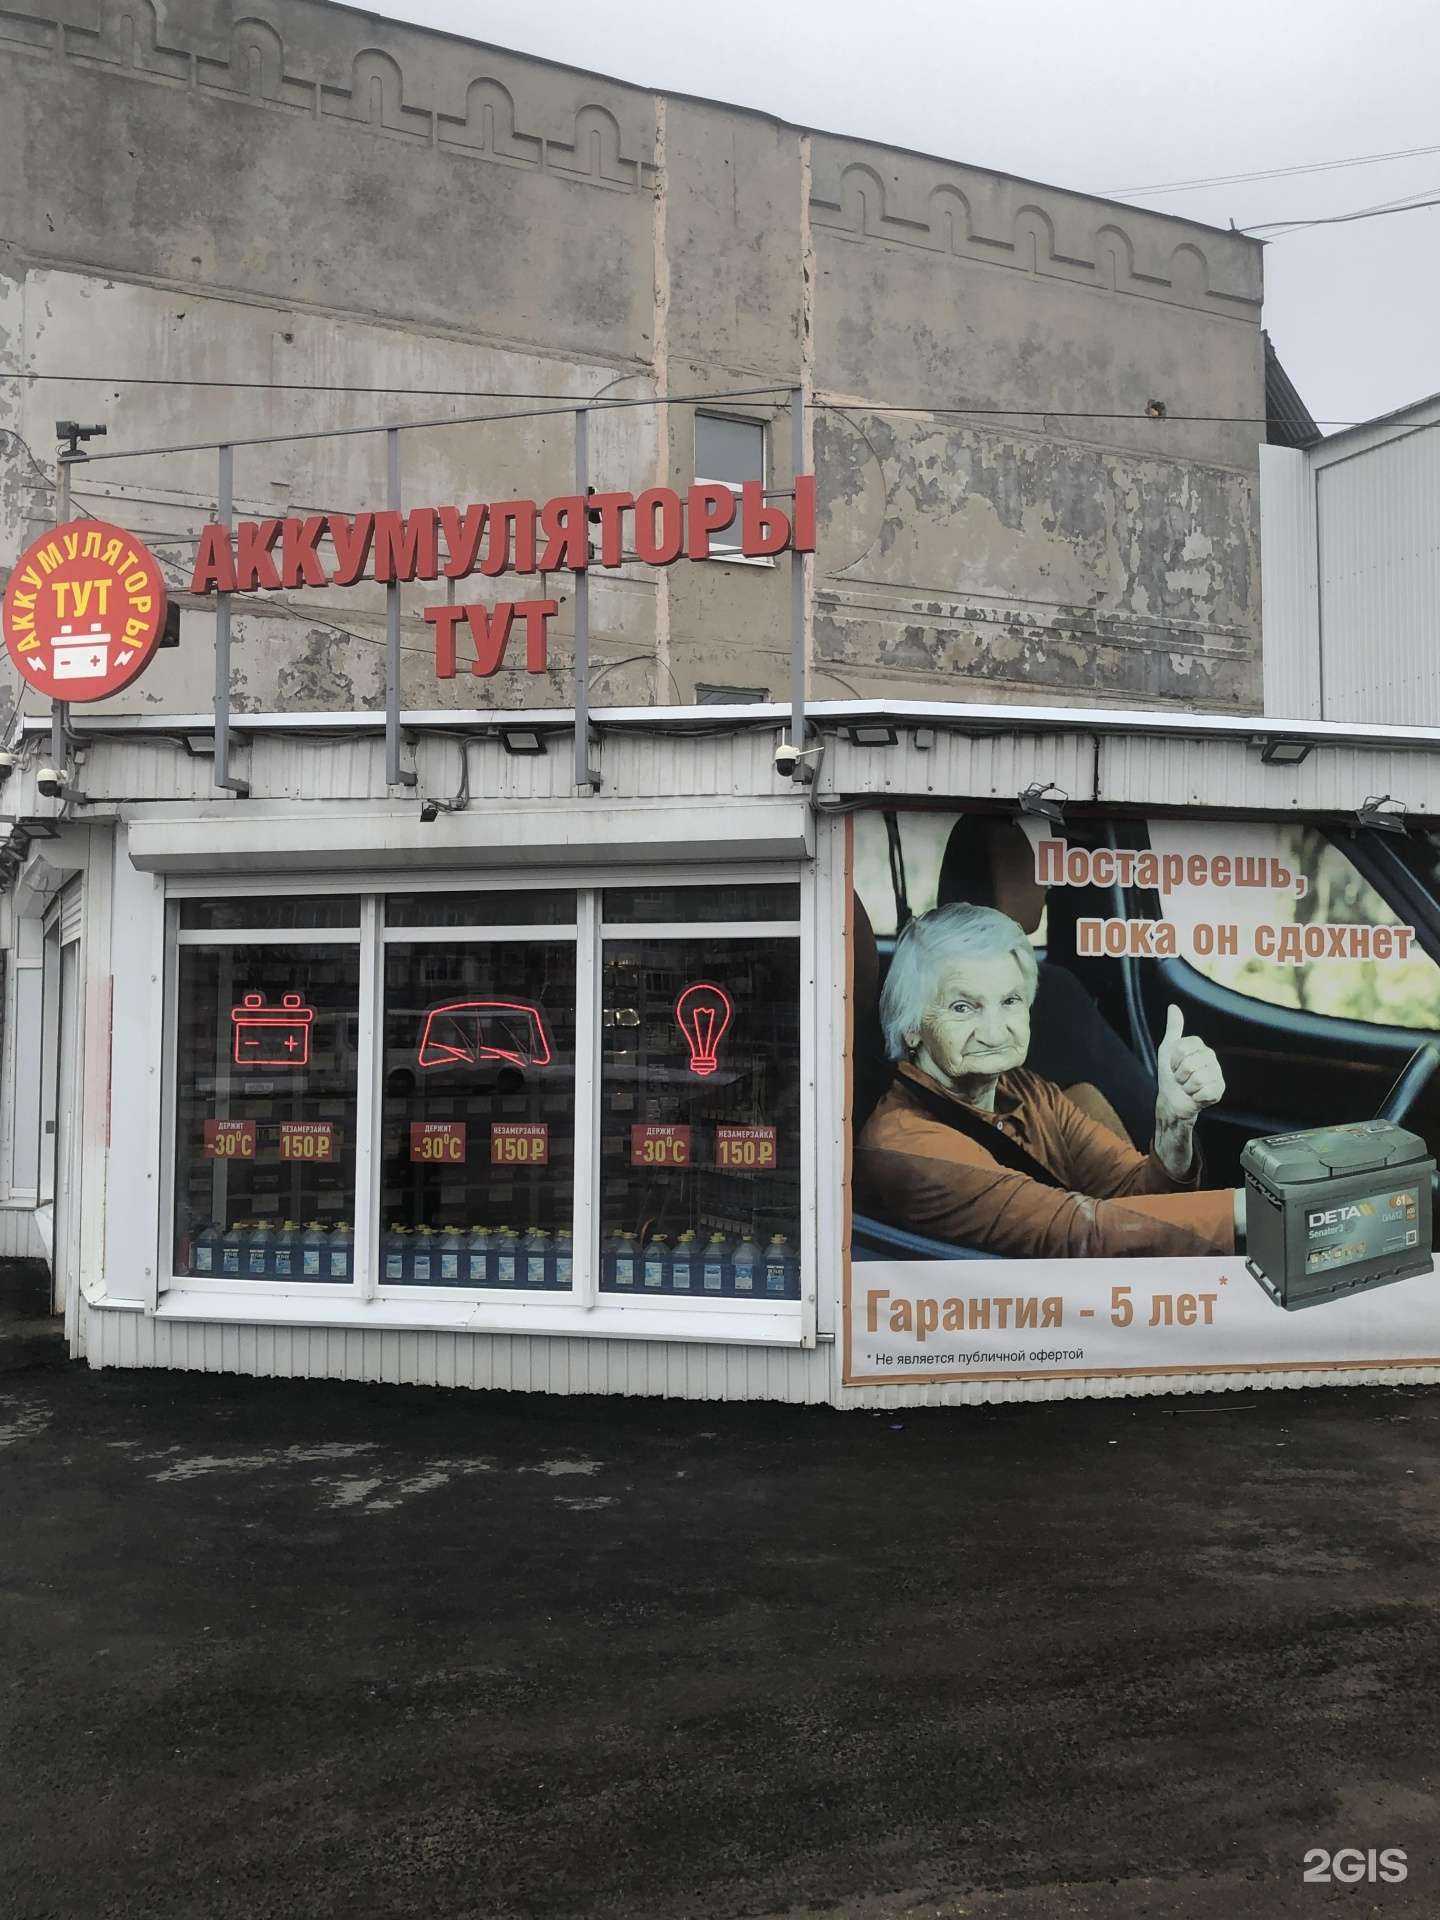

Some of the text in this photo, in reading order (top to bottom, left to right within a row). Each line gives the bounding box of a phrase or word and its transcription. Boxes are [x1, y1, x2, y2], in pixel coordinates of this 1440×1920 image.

[190, 475, 816, 595] АККУМУЛЯТОРЫ
[12, 531, 152, 653] АККУМУЛЯТОРЫ
[51, 578, 113, 619] ТУТ
[424, 600, 558, 680] ТУТ
[1037, 840, 1308, 896] Постареешь,
[1079, 920, 1415, 964] пока он сдохнет
[218, 1122, 244, 1130] ДЕРЖИТ
[281, 1124, 331, 1134] НЕЗАМЕРЗАЙКА
[424, 1124, 452, 1133] ДЕРЖИТ
[493, 1126, 546, 1135] НЕЗАМЕРЗАЙКА
[646, 1127, 675, 1136] ДЕРЖИТ
[718, 1129, 774, 1139] НЕЗАМЕРЗАЙКА
[1308, 1205, 1361, 1228] DETA
[866, 1289, 1064, 1342] Гарантия
[1110, 1286, 1134, 1328] 5
[875, 1347, 1084, 1366] Не является публичной офертой
